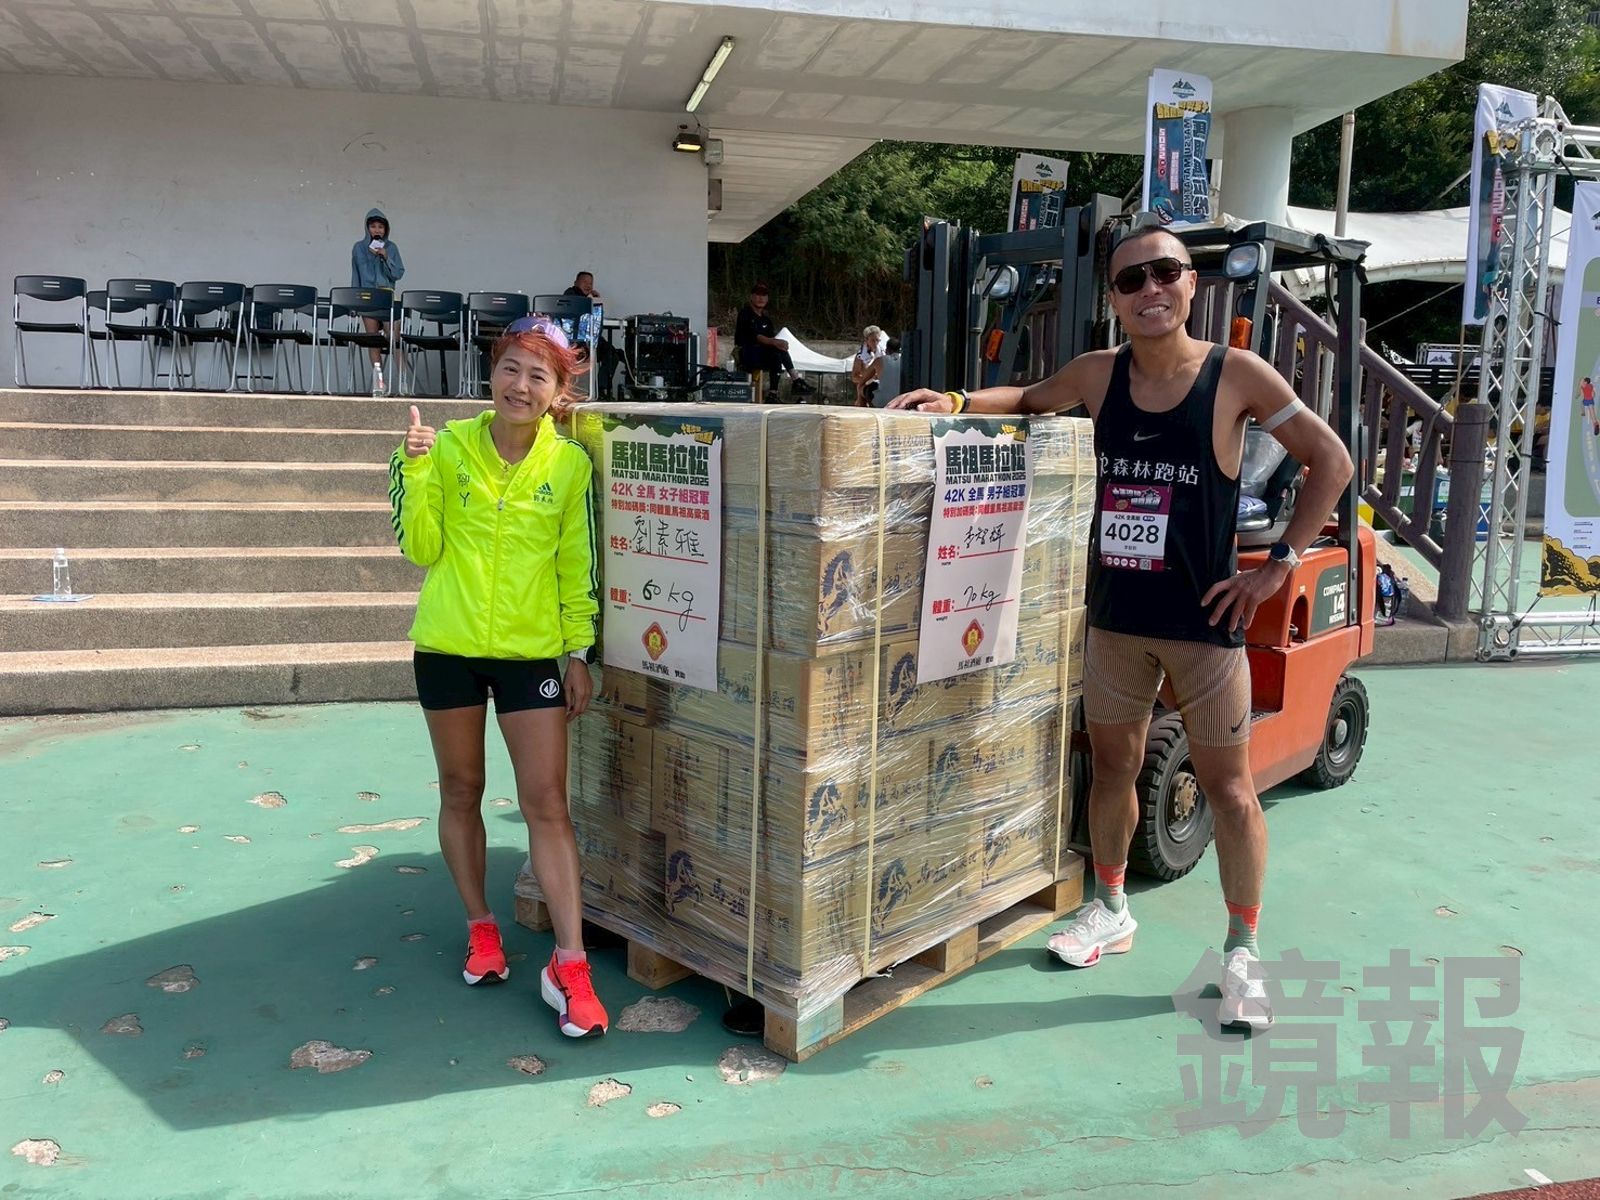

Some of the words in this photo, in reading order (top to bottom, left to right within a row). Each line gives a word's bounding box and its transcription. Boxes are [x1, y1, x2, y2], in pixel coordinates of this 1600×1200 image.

[612, 441, 709, 476] 馬祖馬拉松
[945, 444, 1026, 474] 馬祖馬拉松
[611, 469, 640, 480] MATSU
[642, 471, 689, 485] MARATHON
[690, 476, 709, 486] 2025
[945, 475, 971, 485] MATSU
[973, 473, 1011, 484] MARATHON
[1012, 472, 1026, 481] 2025
[611, 483, 634, 497] 42K
[637, 484, 656, 500] 全馬
[659, 487, 710, 505] 女子組冠軍
[944, 488, 965, 503] 42K
[968, 486, 985, 502] 全馬
[987, 484, 1026, 500] 男子組冠軍
[1105, 523, 1159, 543] 4028
[1323, 582, 1346, 596] COMPACT
[1333, 593, 1345, 614] 14
